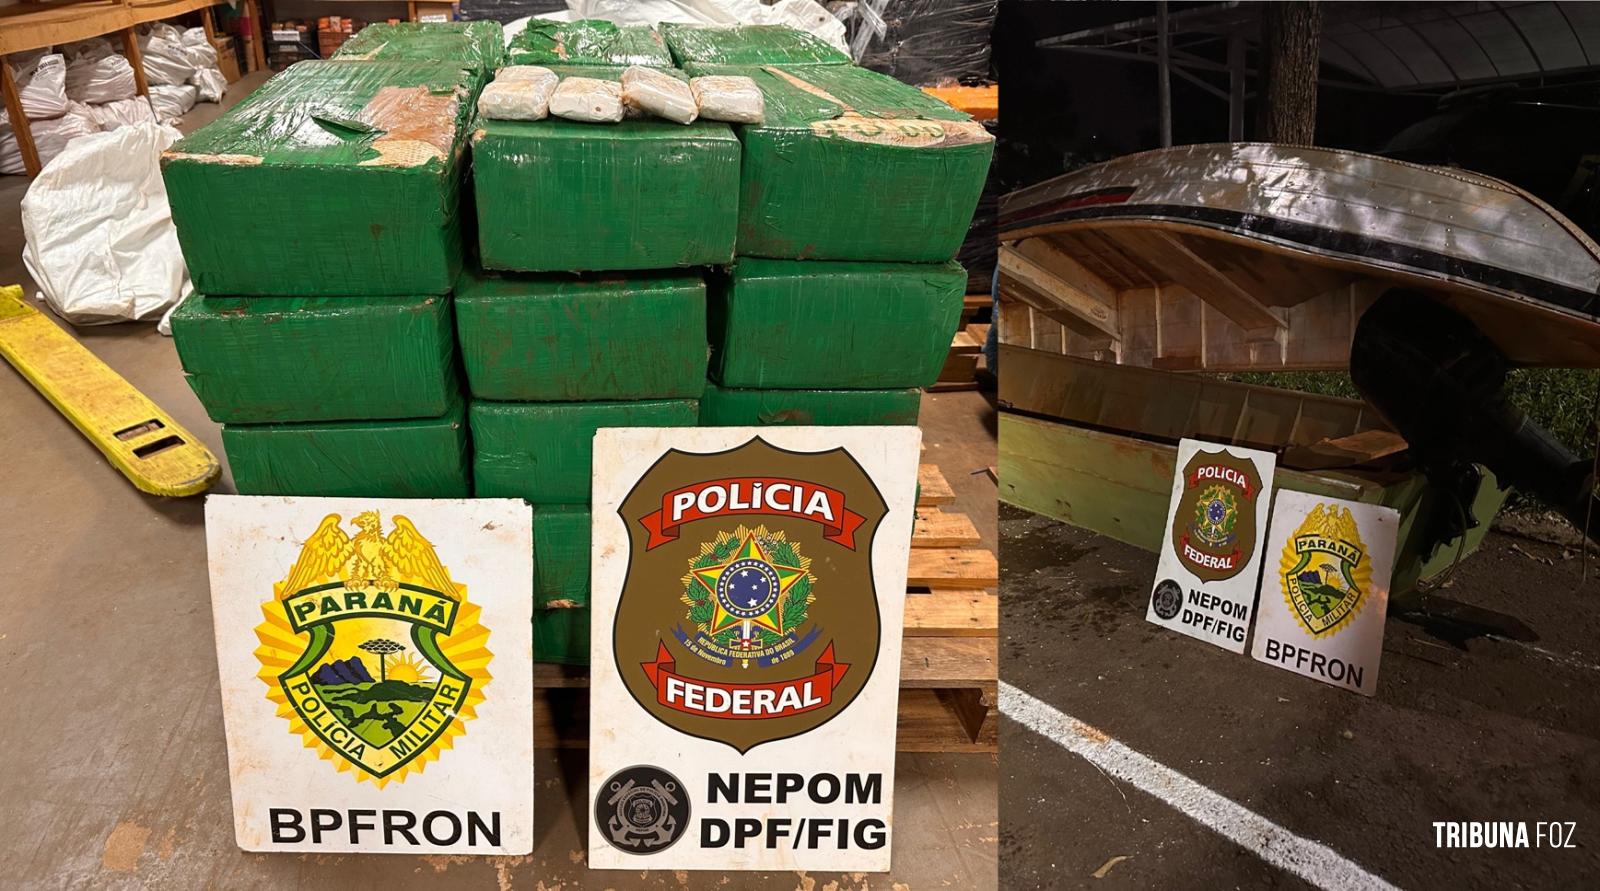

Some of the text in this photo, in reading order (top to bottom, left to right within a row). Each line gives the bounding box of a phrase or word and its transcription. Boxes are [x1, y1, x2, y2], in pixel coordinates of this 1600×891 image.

[1184, 544, 1233, 569] FEDERAL
[1299, 539, 1357, 562] PARANÁ
[294, 591, 447, 625] PARANÁ
[1188, 588, 1248, 621] NEPOM
[1321, 592, 1356, 627] MILITAR
[1181, 608, 1246, 643] DPF/FIG
[683, 638, 727, 666] 15 de Novembro
[728, 648, 765, 659] FEDERATIVA
[765, 646, 775, 656] DO
[775, 637, 796, 653] BRASIL
[770, 656, 780, 665] de
[1265, 638, 1364, 688] BPFRON
[667, 677, 822, 715] FEDERAL
[291, 681, 366, 761] POLÍCIA
[390, 684, 460, 760] MILITAR
[707, 772, 883, 805] NEPOM
[268, 807, 502, 847] BPFRON
[700, 818, 887, 850] DPF/FIG
